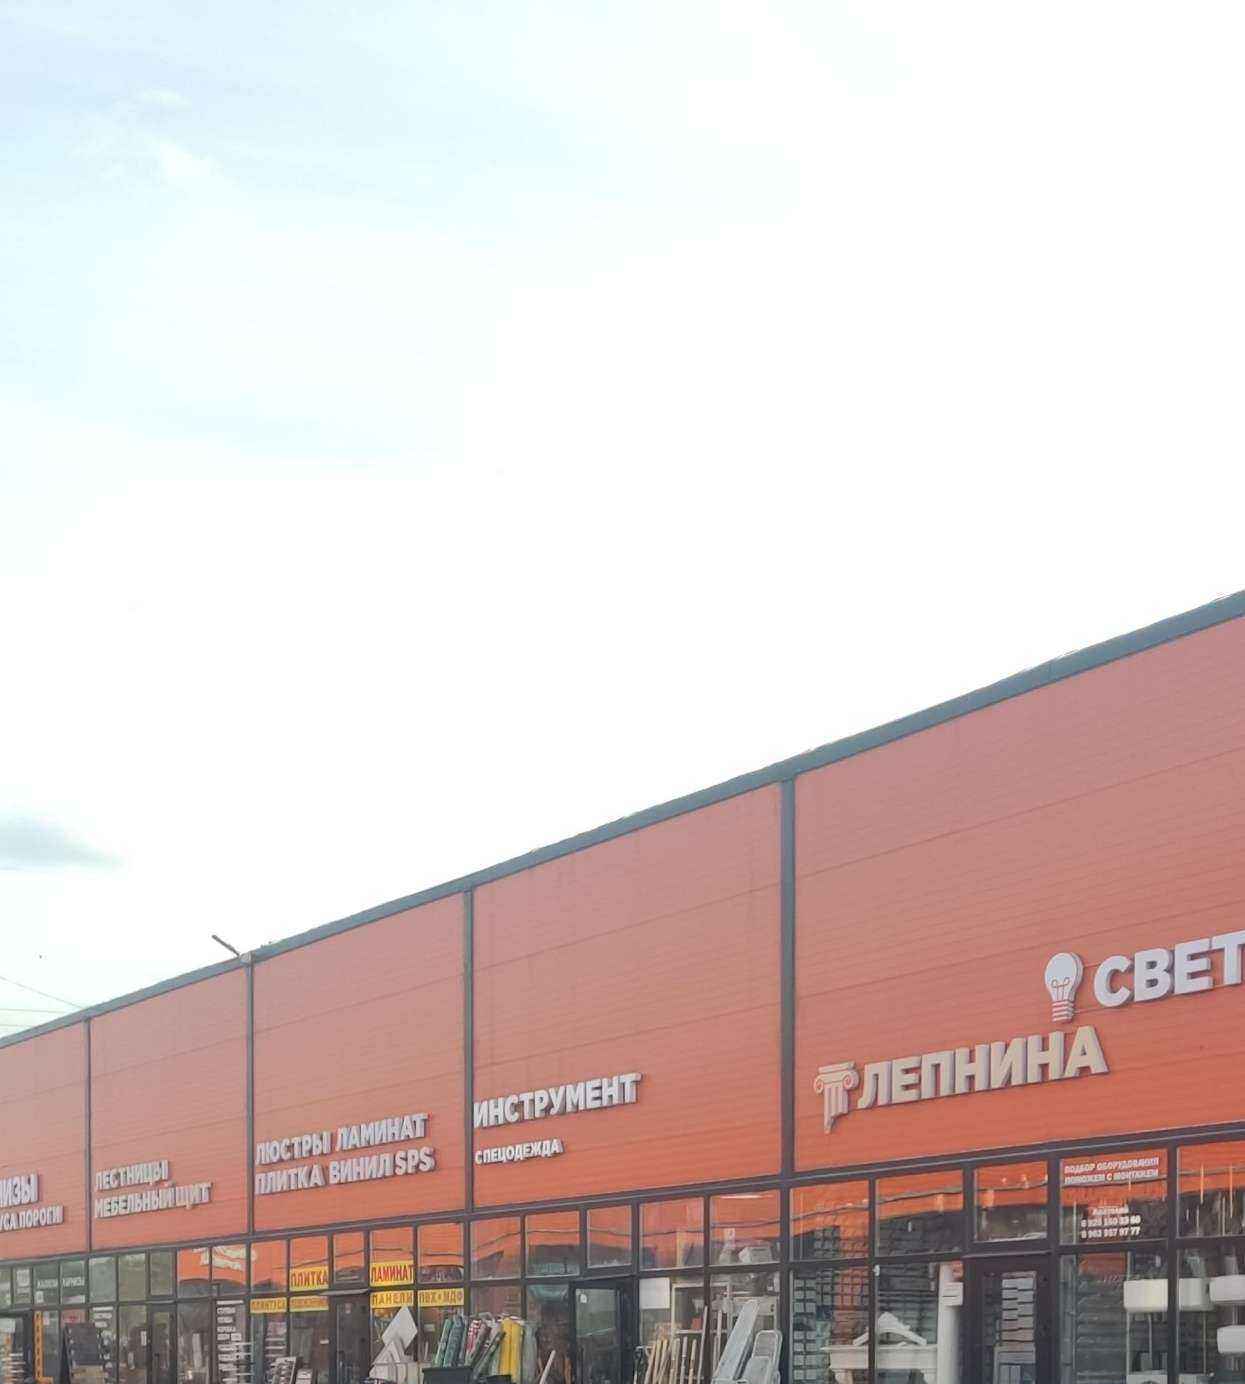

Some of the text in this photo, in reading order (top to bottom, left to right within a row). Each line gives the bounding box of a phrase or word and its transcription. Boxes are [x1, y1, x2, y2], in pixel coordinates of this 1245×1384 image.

[1094, 930, 1245, 1007] СВЕТ
[857, 1026, 1108, 1109] ЛЕПНИНА
[474, 1072, 642, 1128] ИНСТРУМЕНТ
[256, 1113, 429, 1165] ЛЮСТРЫ ЛАМИНАТ
[475, 1139, 564, 1164] СПЕЦОДЕЖДА
[96, 1160, 168, 1190] ЛЕСТНИЦЫ
[255, 1146, 435, 1195] ПЛИТКА ВИНИЛ SPS
[19, 1205, 64, 1227] ПОРОГИ
[95, 1182, 211, 1218] МЕБЕЛЬНЫЙ ЩИТ
[291, 1270, 328, 1287] ПЛИТКА
[371, 1264, 414, 1282] ЛАМИНАТ
[372, 1290, 413, 1306] ПАНЕЛИ
